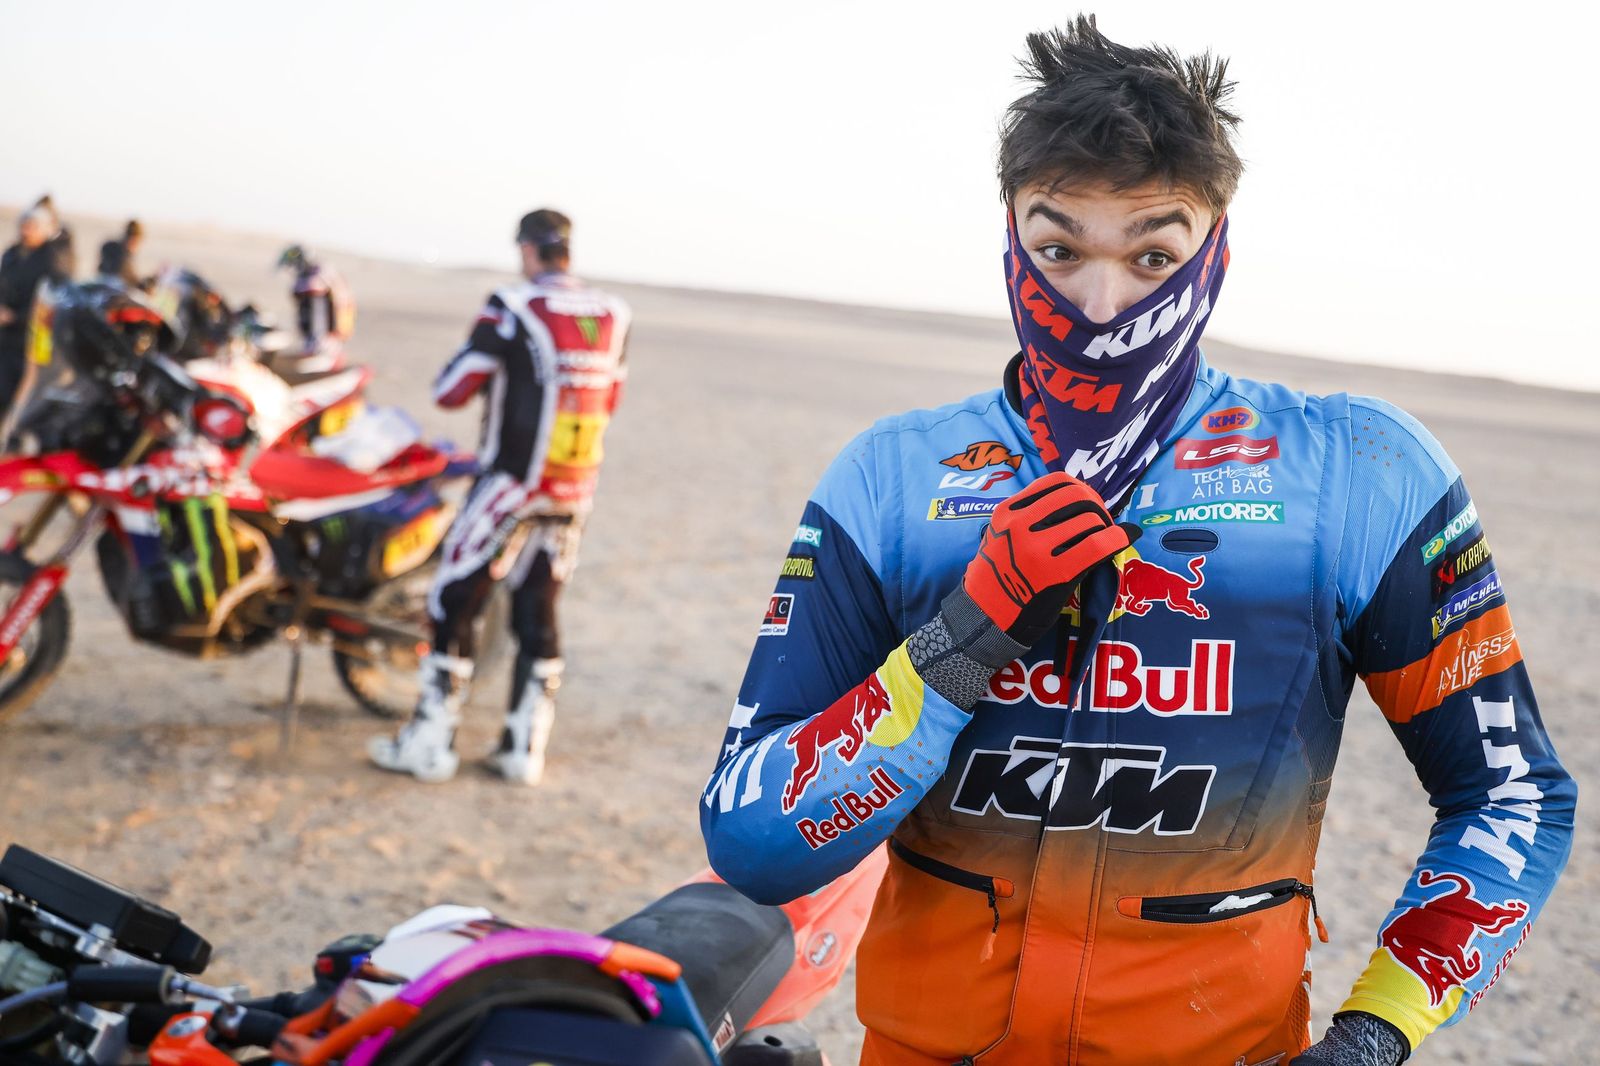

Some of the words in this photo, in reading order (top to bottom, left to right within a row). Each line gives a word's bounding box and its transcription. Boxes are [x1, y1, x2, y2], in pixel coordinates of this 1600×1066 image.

[1082, 283, 1193, 360] KTM
[1208, 413, 1250, 428] KH-7
[1174, 503, 1279, 522] MOTOREX
[1192, 481, 1224, 500] AIR
[1232, 479, 1273, 495] BAG
[974, 636, 1082, 711] ed
[1090, 639, 1236, 717] Bull
[795, 797, 859, 851] Red
[840, 765, 905, 823] Bull
[950, 735, 1217, 836] KTM
